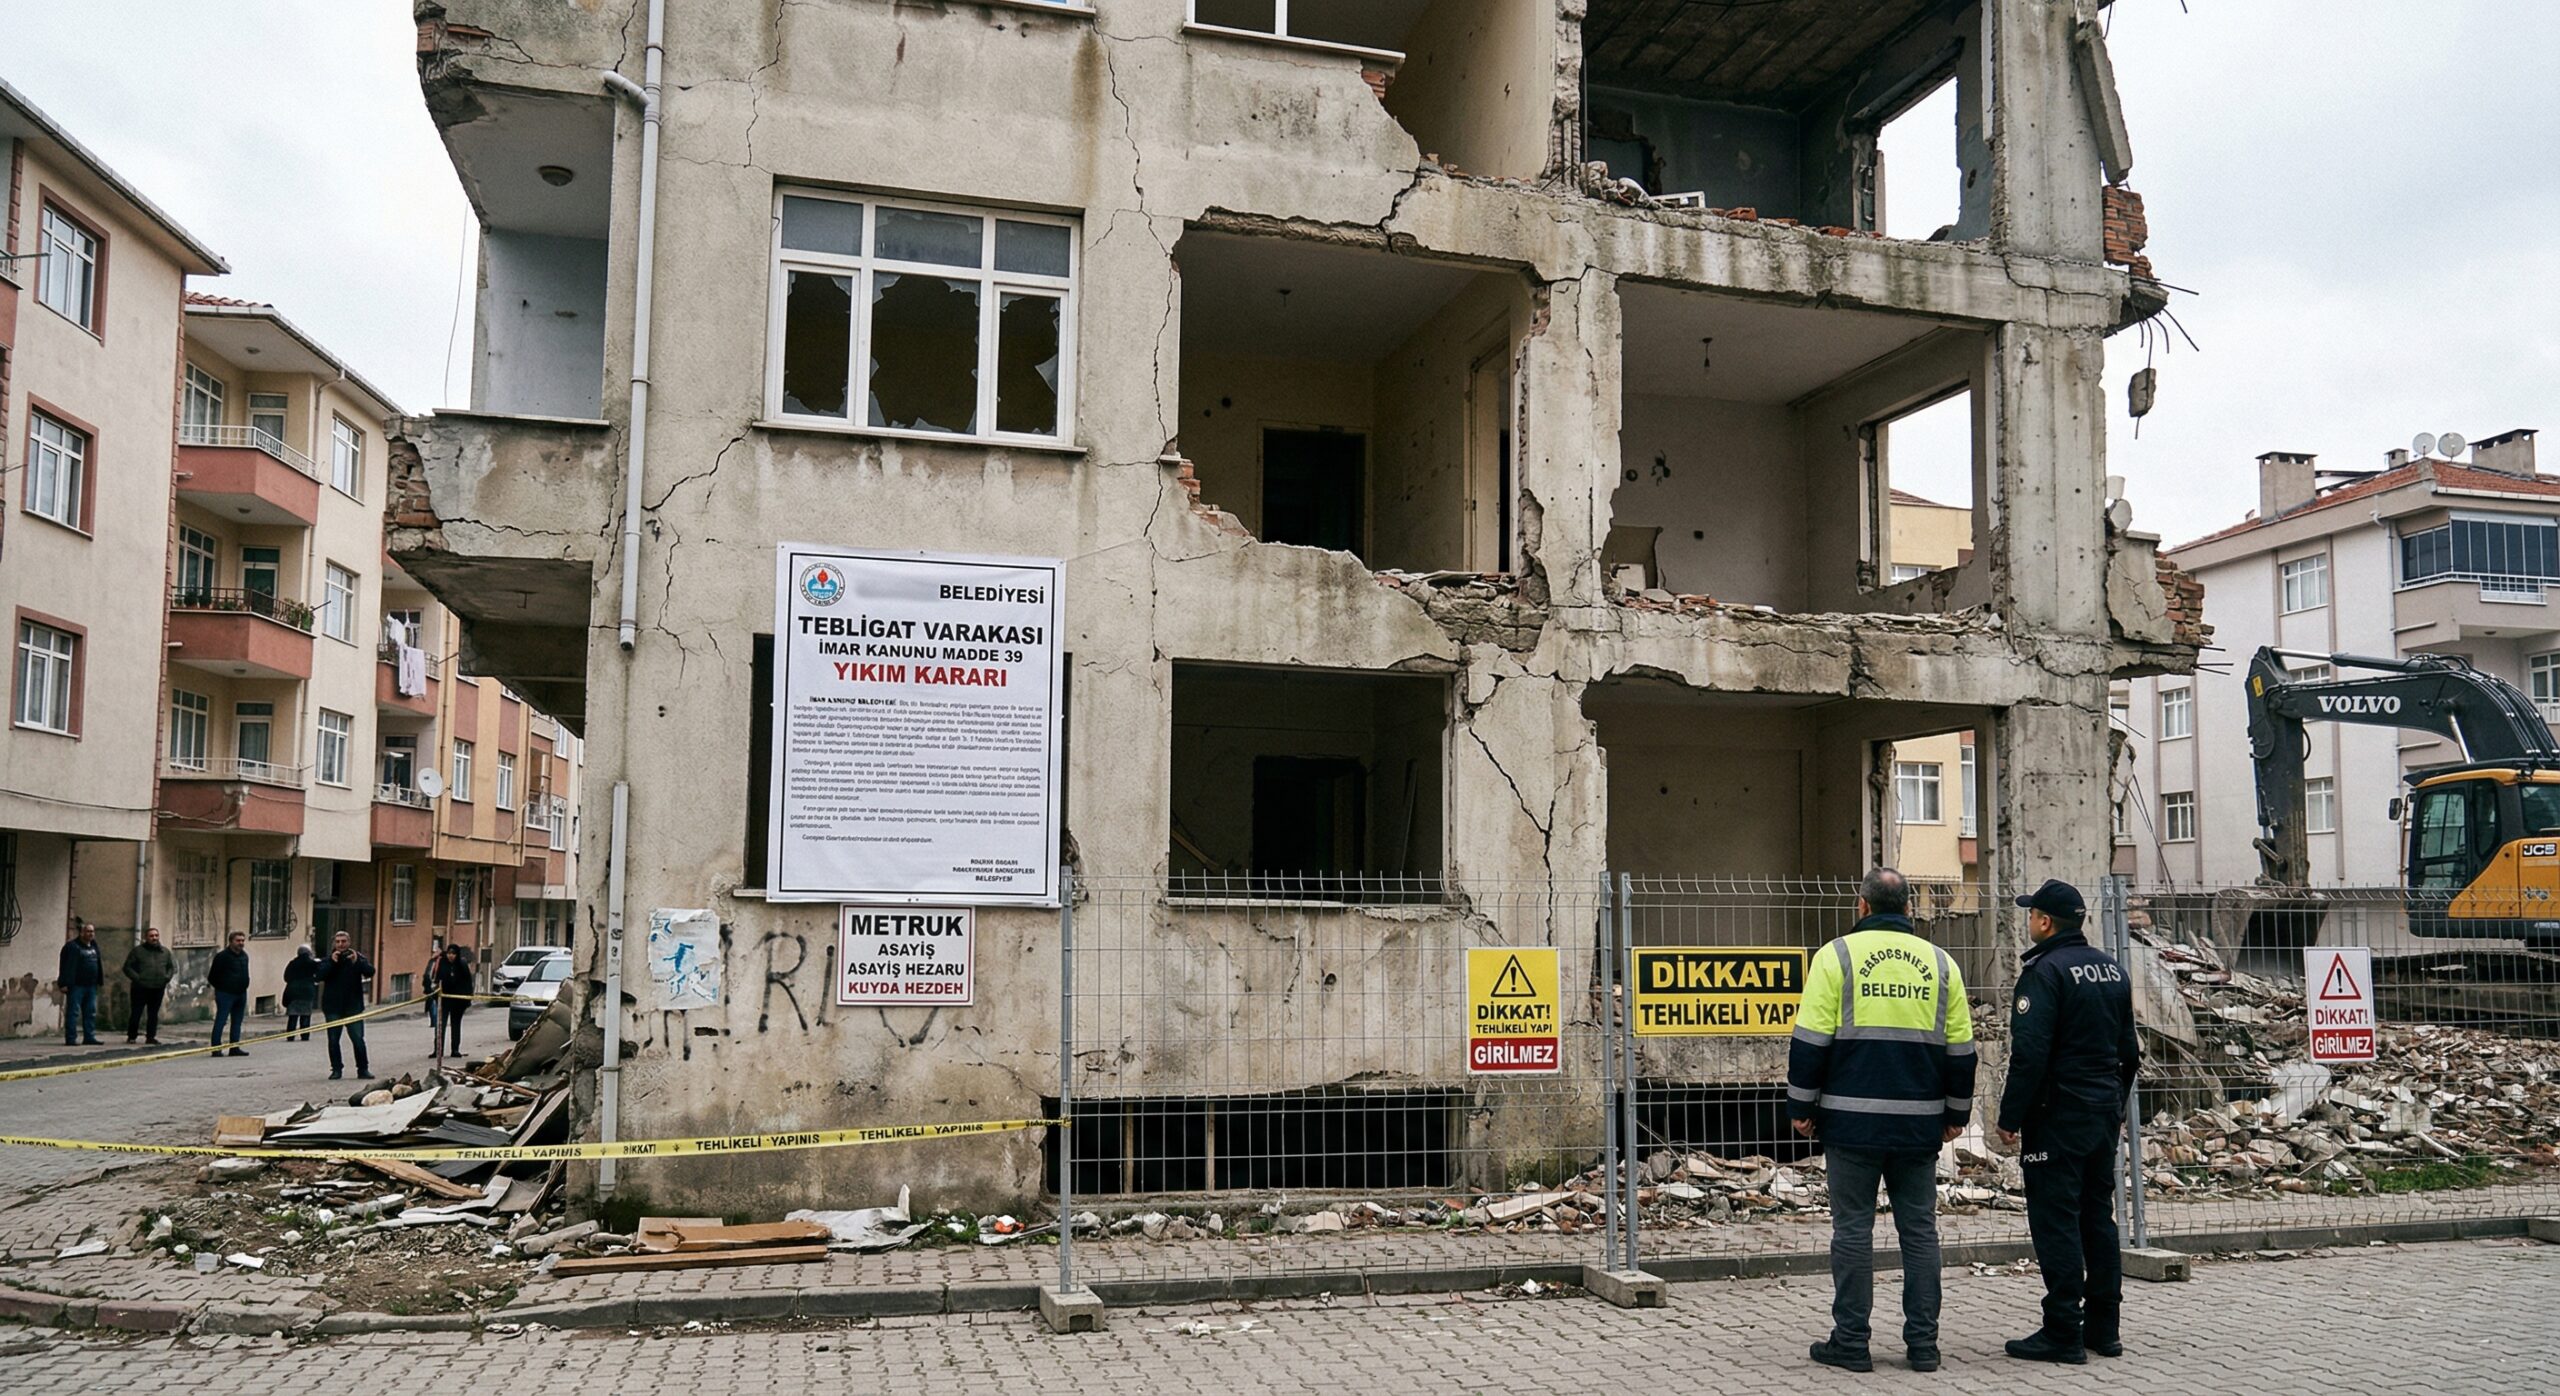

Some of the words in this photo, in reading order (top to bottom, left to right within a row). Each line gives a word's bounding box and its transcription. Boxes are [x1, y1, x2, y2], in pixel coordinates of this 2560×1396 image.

[940, 584, 1044, 604] BELEDİYESİ
[798, 615, 916, 639] TEBLİGAT
[924, 622, 1043, 645] VARAKASI
[819, 639, 861, 656] İMAR
[866, 644, 937, 659] KANUNU
[943, 649, 999, 662] MADDE
[1005, 651, 1024, 663] 39
[834, 662, 905, 683] YIKIM
[914, 666, 1007, 687] KARARI
[2317, 695, 2401, 714] VOLVO
[2524, 844, 2556, 856] JCB
[851, 915, 963, 937] METRUK
[878, 941, 935, 960] ASAYİŞ
[848, 961, 901, 978] ASAYİŞ
[906, 963, 965, 976] HEZARU
[1652, 955, 1791, 988] DİKKAT!
[848, 982, 900, 994] KUYDA
[1862, 982, 1930, 1001] BELEDİYE
[1477, 1001, 1550, 1020] DİKKAT!
[1640, 998, 1748, 1026] TEHLİKELİ
[2315, 1005, 2368, 1025] DİKKAT!
[1476, 1022, 1527, 1034] TEHLİKELİ
[1530, 1023, 1552, 1033] YAPI
[1474, 1041, 1554, 1064] GİRİLMEZ
[2315, 1032, 2371, 1054] GİRİLMEZ
[859, 1125, 925, 1141] TEHLİKELİ
[696, 1135, 761, 1151] TEHLİKELİ
